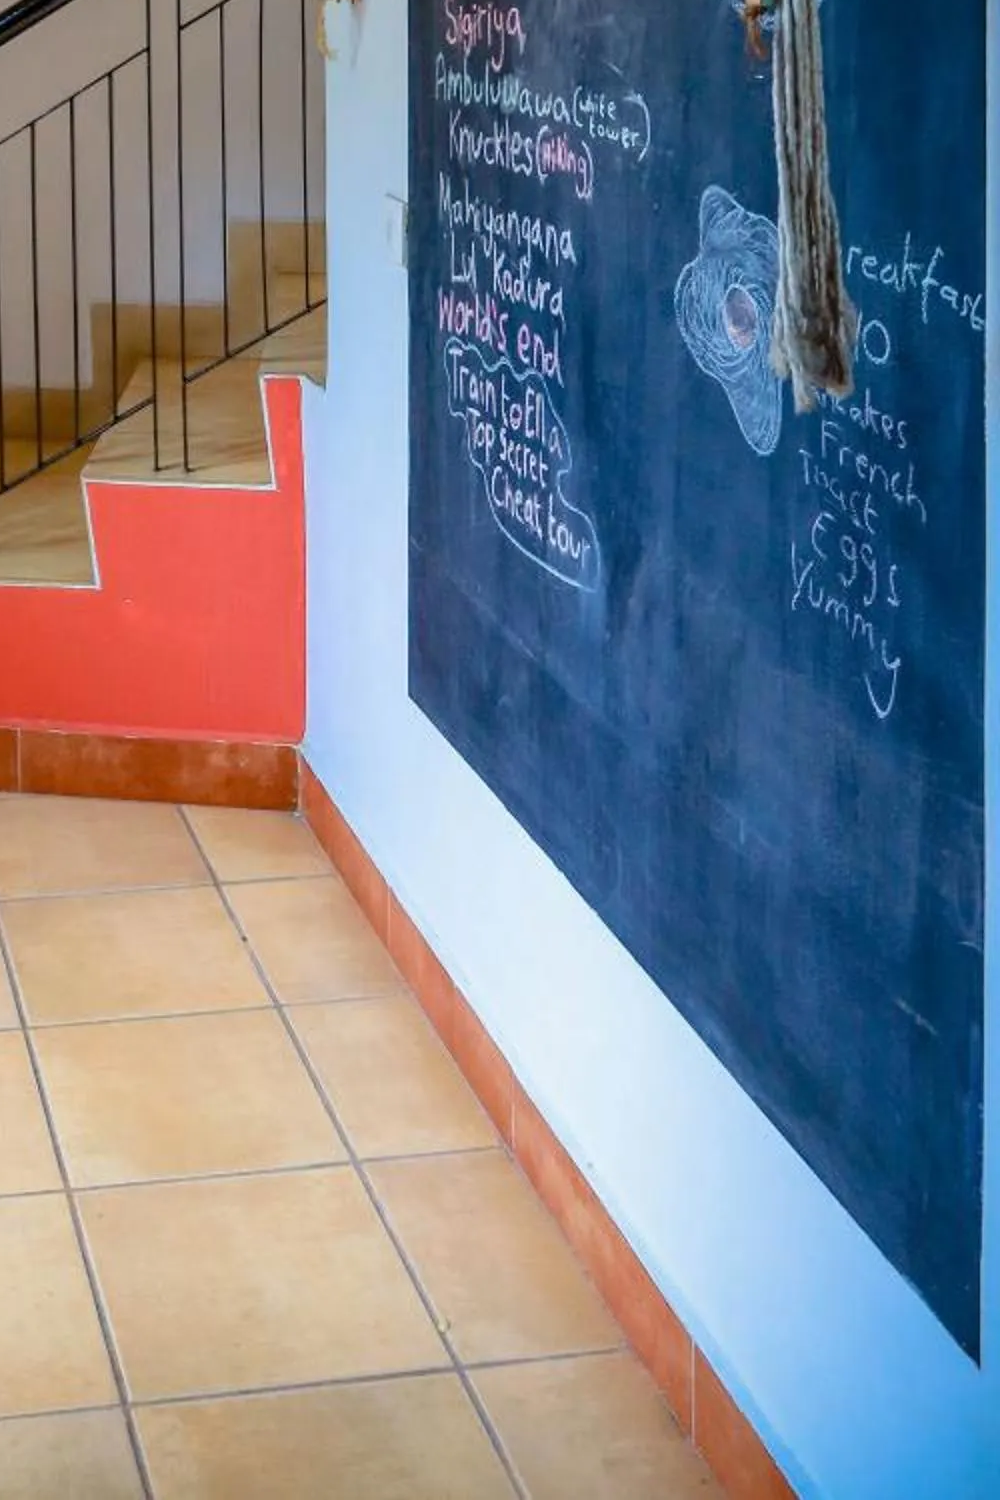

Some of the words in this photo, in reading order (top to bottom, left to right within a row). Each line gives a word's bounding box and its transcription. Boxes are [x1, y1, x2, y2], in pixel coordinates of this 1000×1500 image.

[846, 231, 985, 331] reakfast
[438, 286, 509, 351] World's
[517, 323, 565, 388] end
[450, 348, 497, 419] Train
[501, 373, 523, 430] to
[468, 406, 496, 464] Top
[821, 419, 927, 523] French
[548, 493, 591, 567] tour
[799, 449, 879, 534] Toast
[811, 511, 902, 607] Eggs
